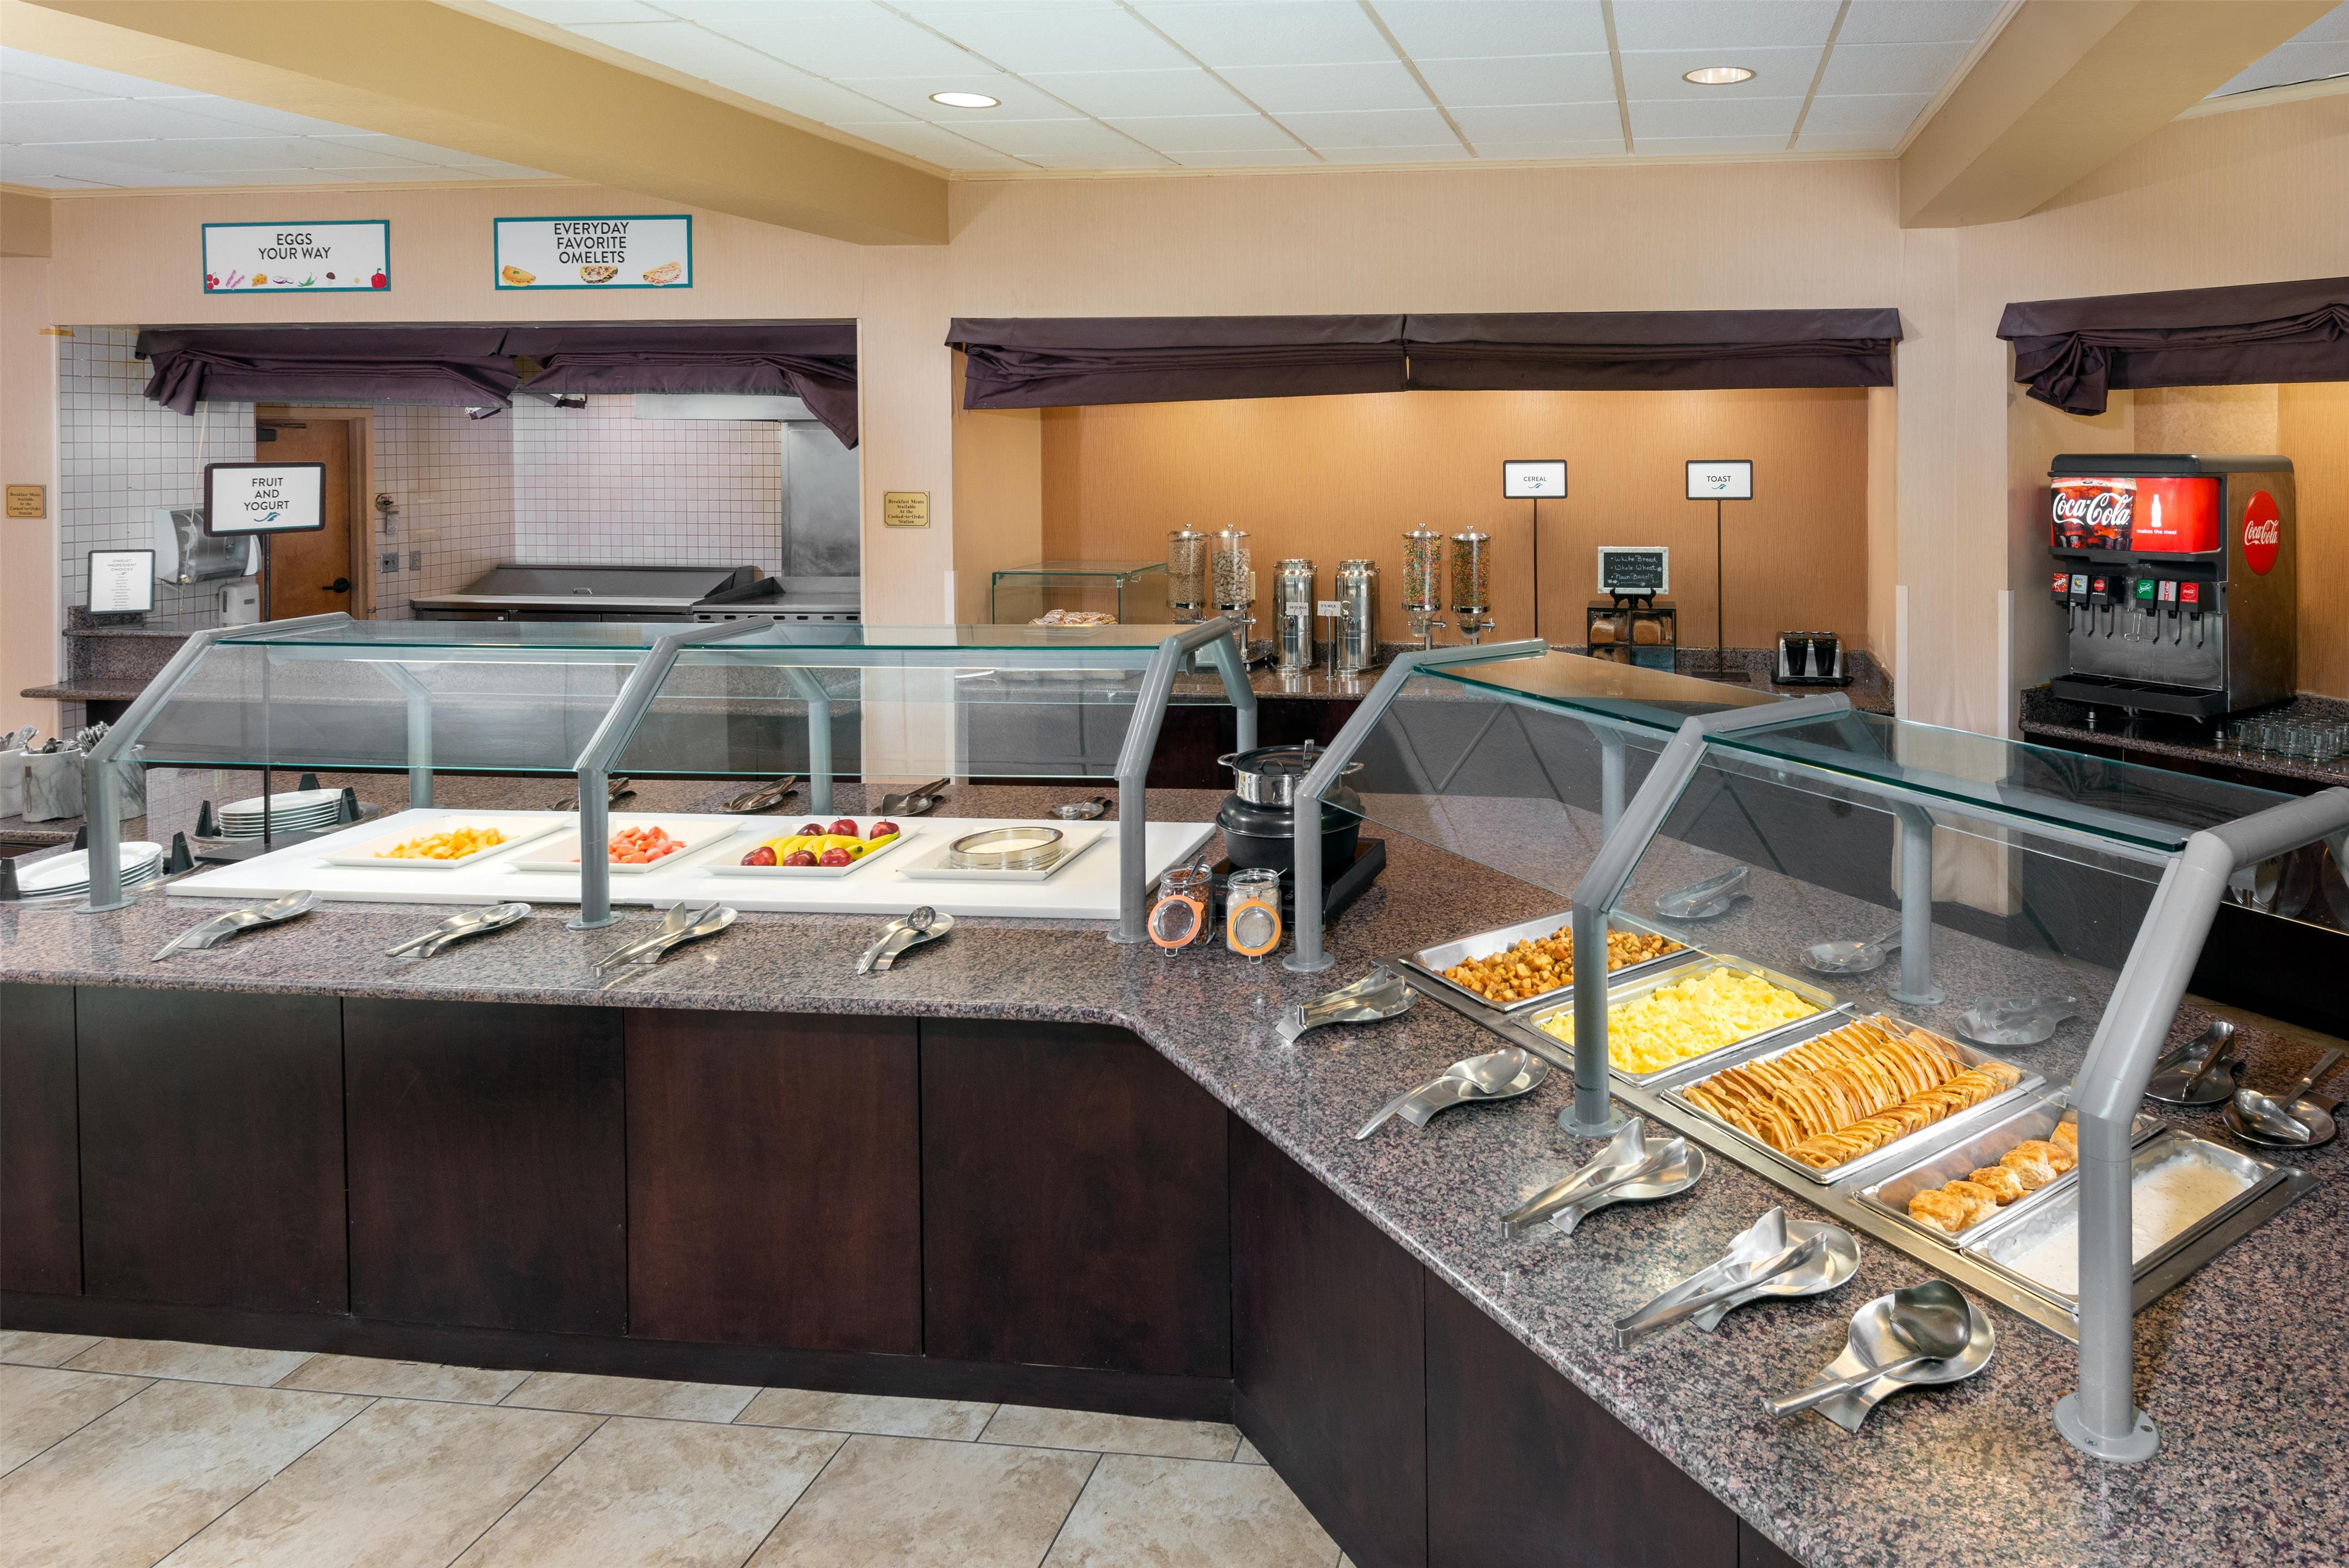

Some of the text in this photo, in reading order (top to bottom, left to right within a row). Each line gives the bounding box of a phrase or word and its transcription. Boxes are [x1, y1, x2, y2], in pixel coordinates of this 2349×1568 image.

[554, 222, 629, 235] EVERYDAY
[277, 233, 313, 245] EGGS
[557, 236, 627, 249] FAVORITE
[258, 247, 331, 260] YOUR WAY
[559, 250, 625, 264] OMELETS
[252, 477, 283, 487] FRUIT
[254, 489, 279, 499] AND
[244, 501, 290, 511] YOGURT
[2053, 492, 2133, 526] Coca-Cola
[2244, 519, 2279, 546] Coca-Cola
[1635, 555, 1658, 563] Bread
[2054, 578, 2066, 587] Pibb
